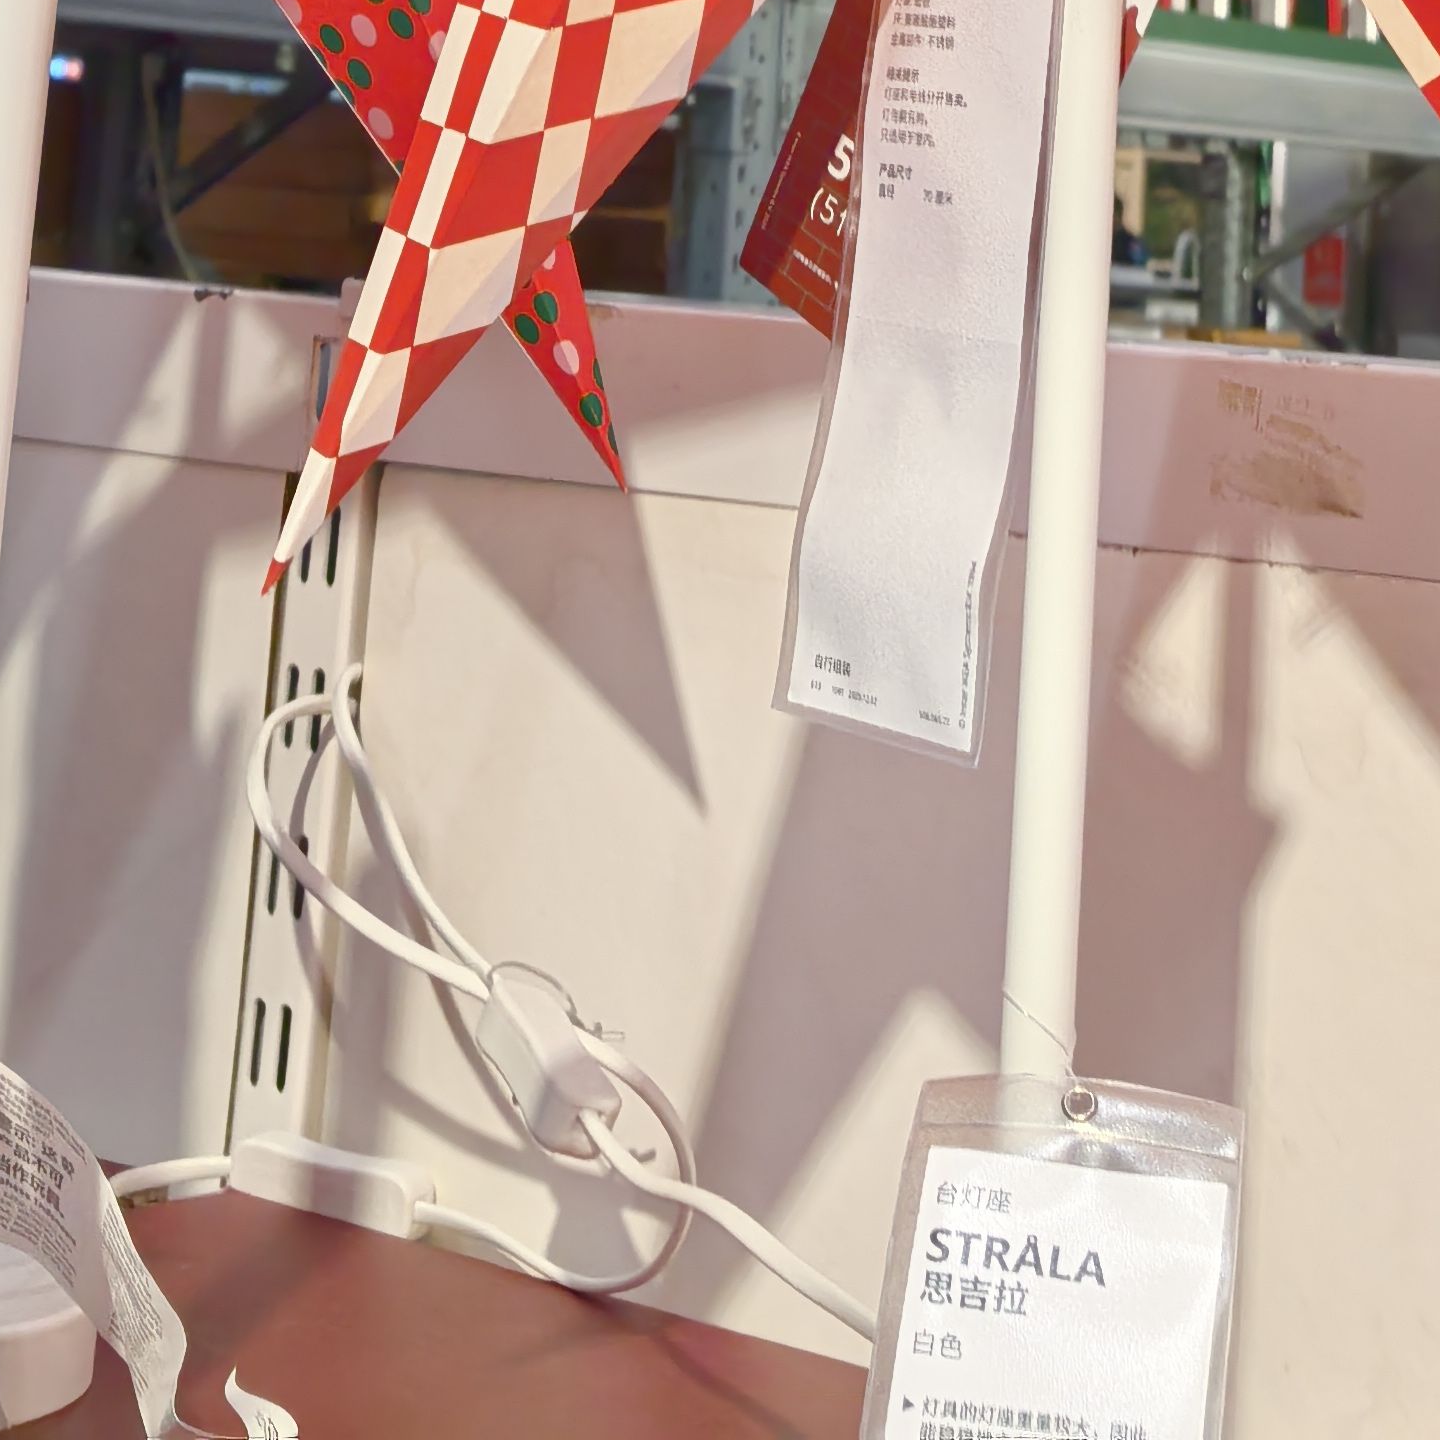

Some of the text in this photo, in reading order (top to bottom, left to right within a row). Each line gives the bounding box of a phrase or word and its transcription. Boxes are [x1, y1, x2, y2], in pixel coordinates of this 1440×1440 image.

[935, 1180, 1012, 1214] 台灯座
[925, 1227, 1106, 1288] STRÅLA
[919, 1269, 1029, 1316] 思吉拉
[912, 1328, 963, 1361] 白色
